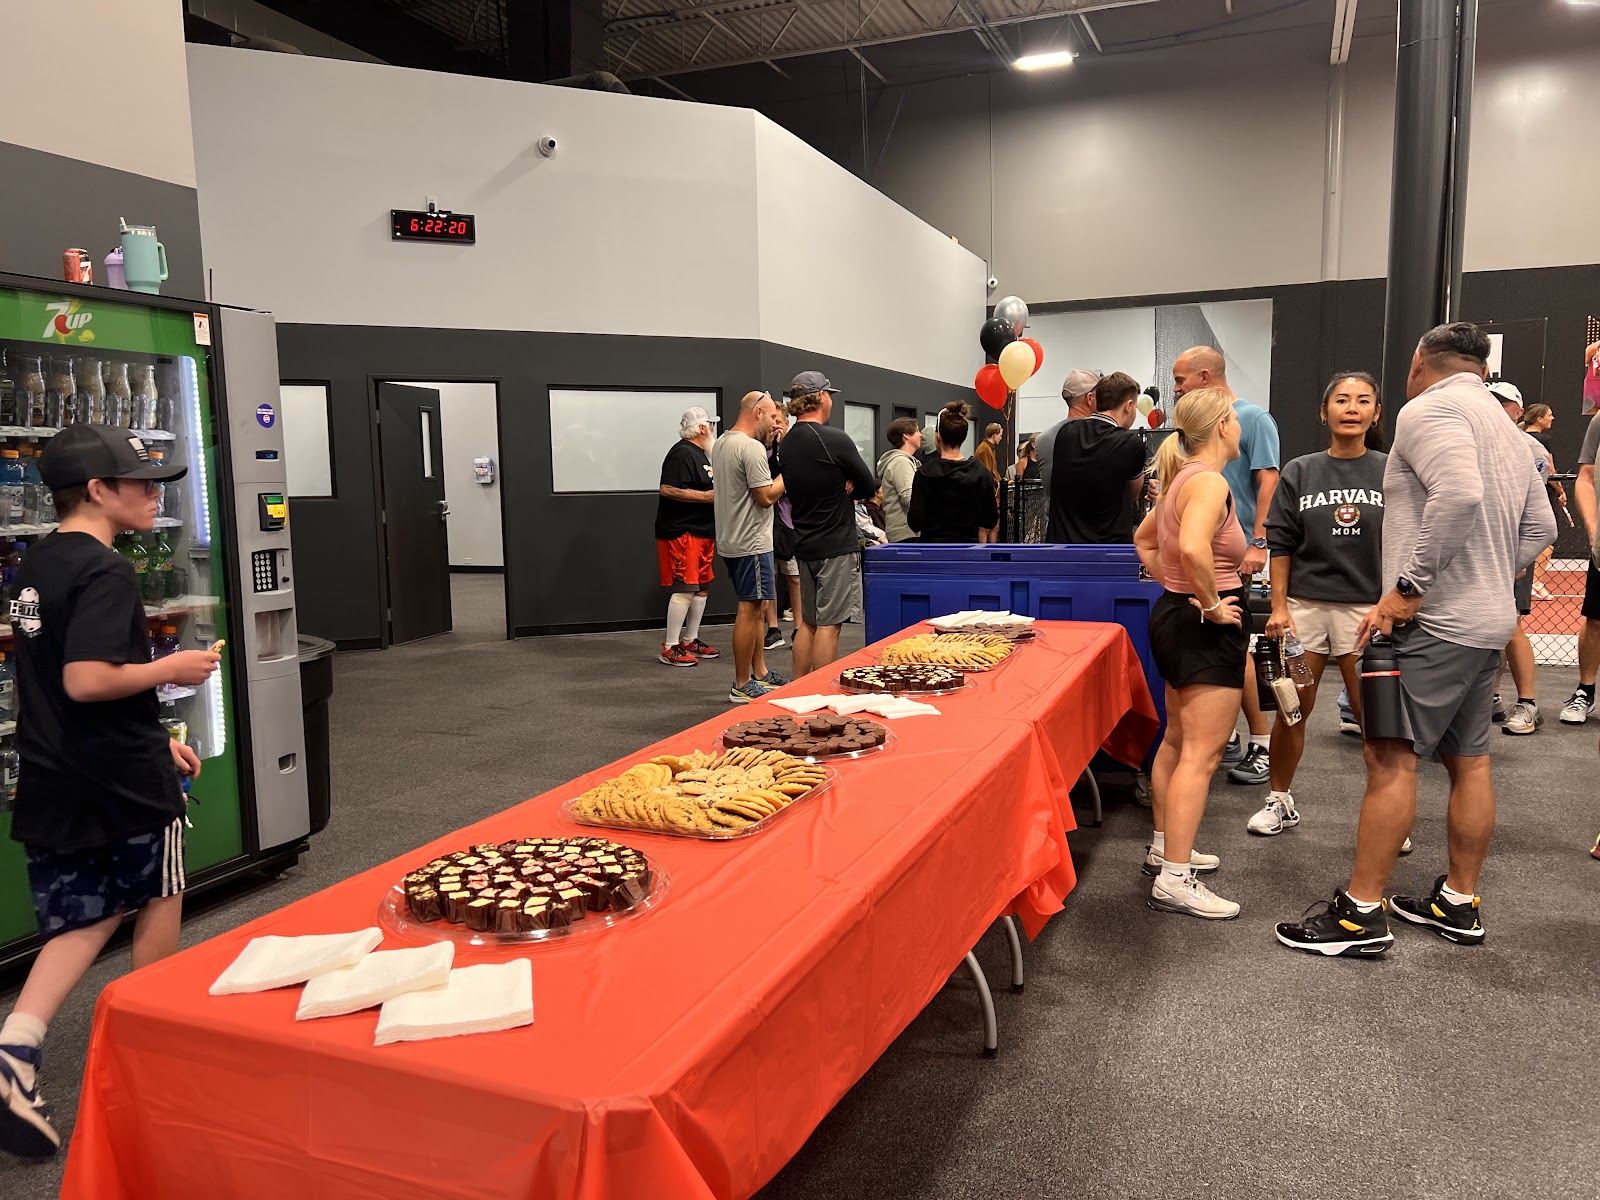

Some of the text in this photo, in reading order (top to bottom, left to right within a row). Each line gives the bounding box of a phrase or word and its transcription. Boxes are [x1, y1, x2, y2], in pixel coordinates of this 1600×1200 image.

[410, 218, 467, 235] 6:22:20
[42, 301, 93, 339] 7UP
[1299, 488, 1386, 512] HARVAR
[1332, 527, 1361, 536] MOM
